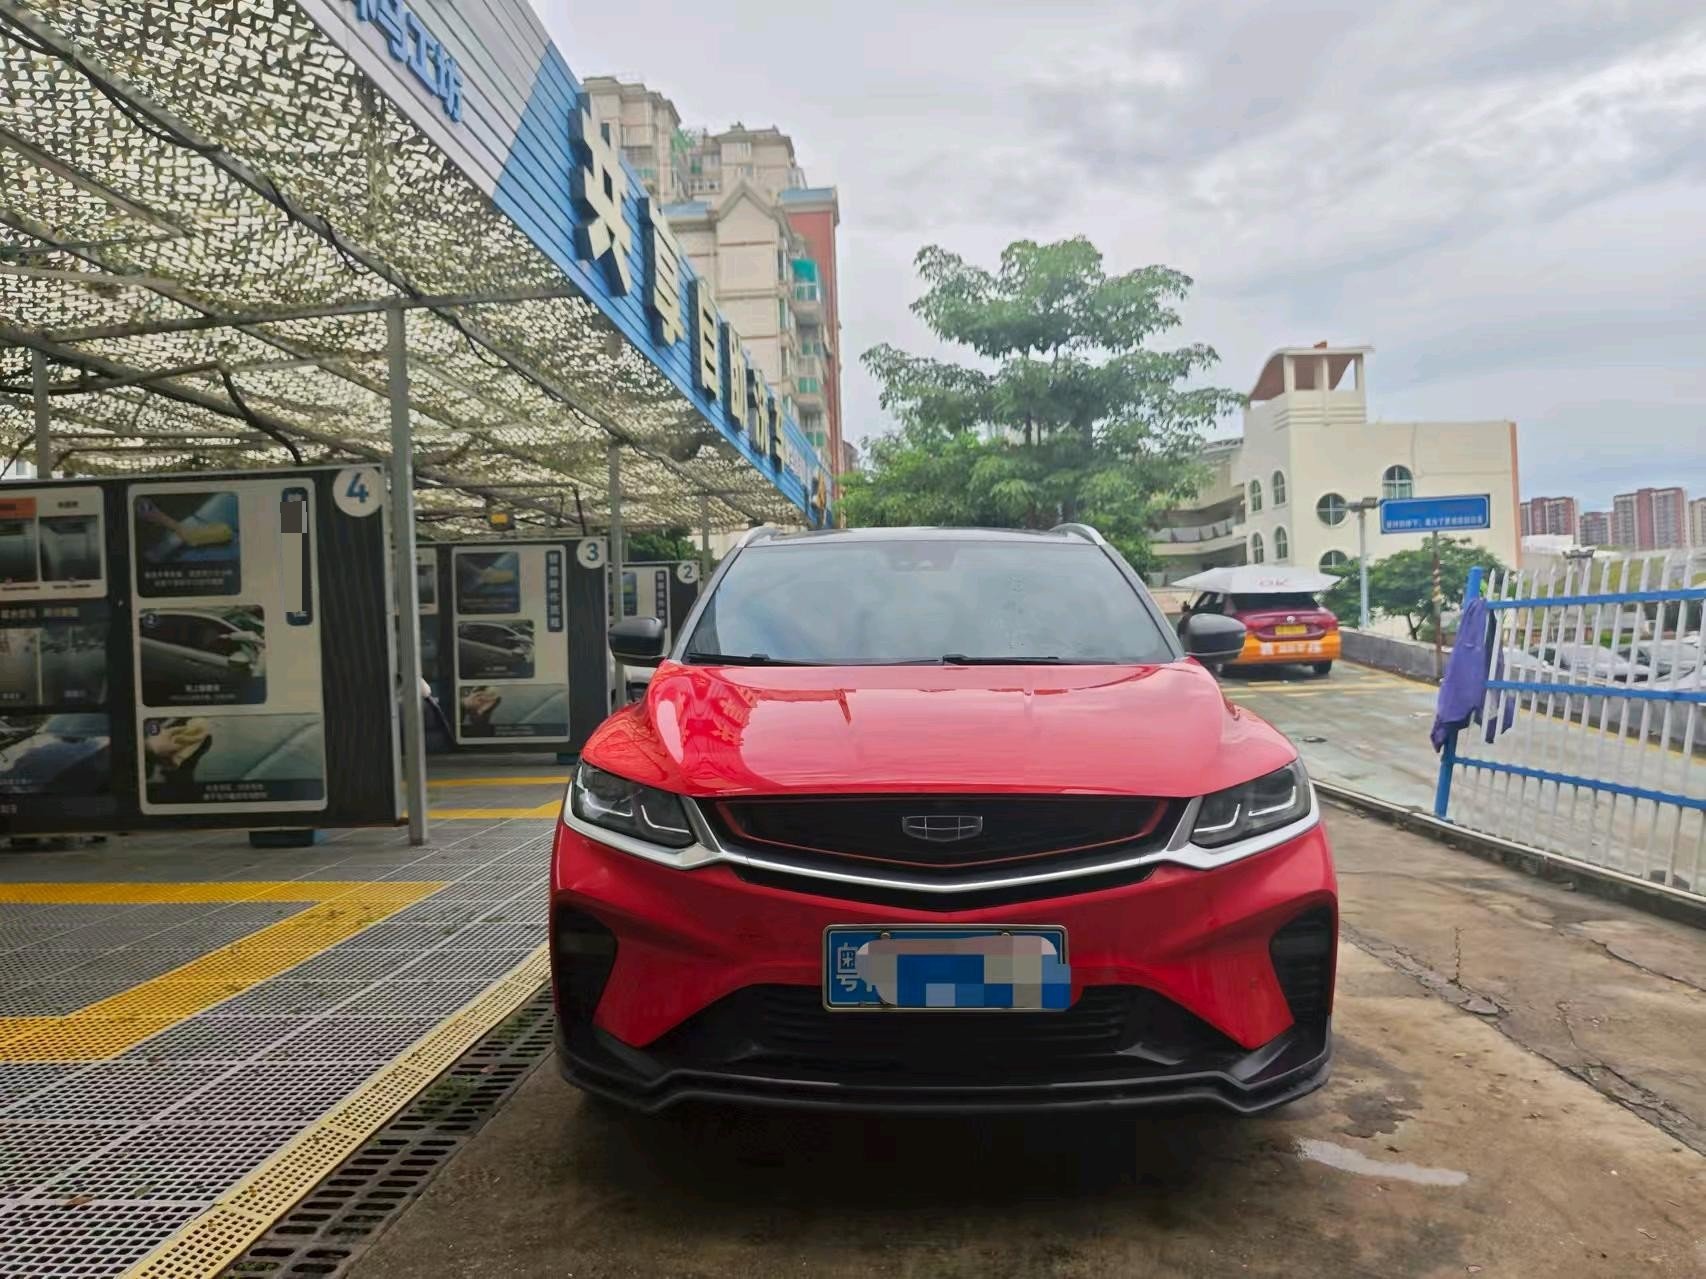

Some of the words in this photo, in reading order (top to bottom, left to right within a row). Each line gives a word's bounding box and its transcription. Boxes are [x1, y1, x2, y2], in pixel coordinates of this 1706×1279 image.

[345, 472, 369, 503] 4
[586, 543, 600, 561] 3
[683, 565, 693, 579] 2
